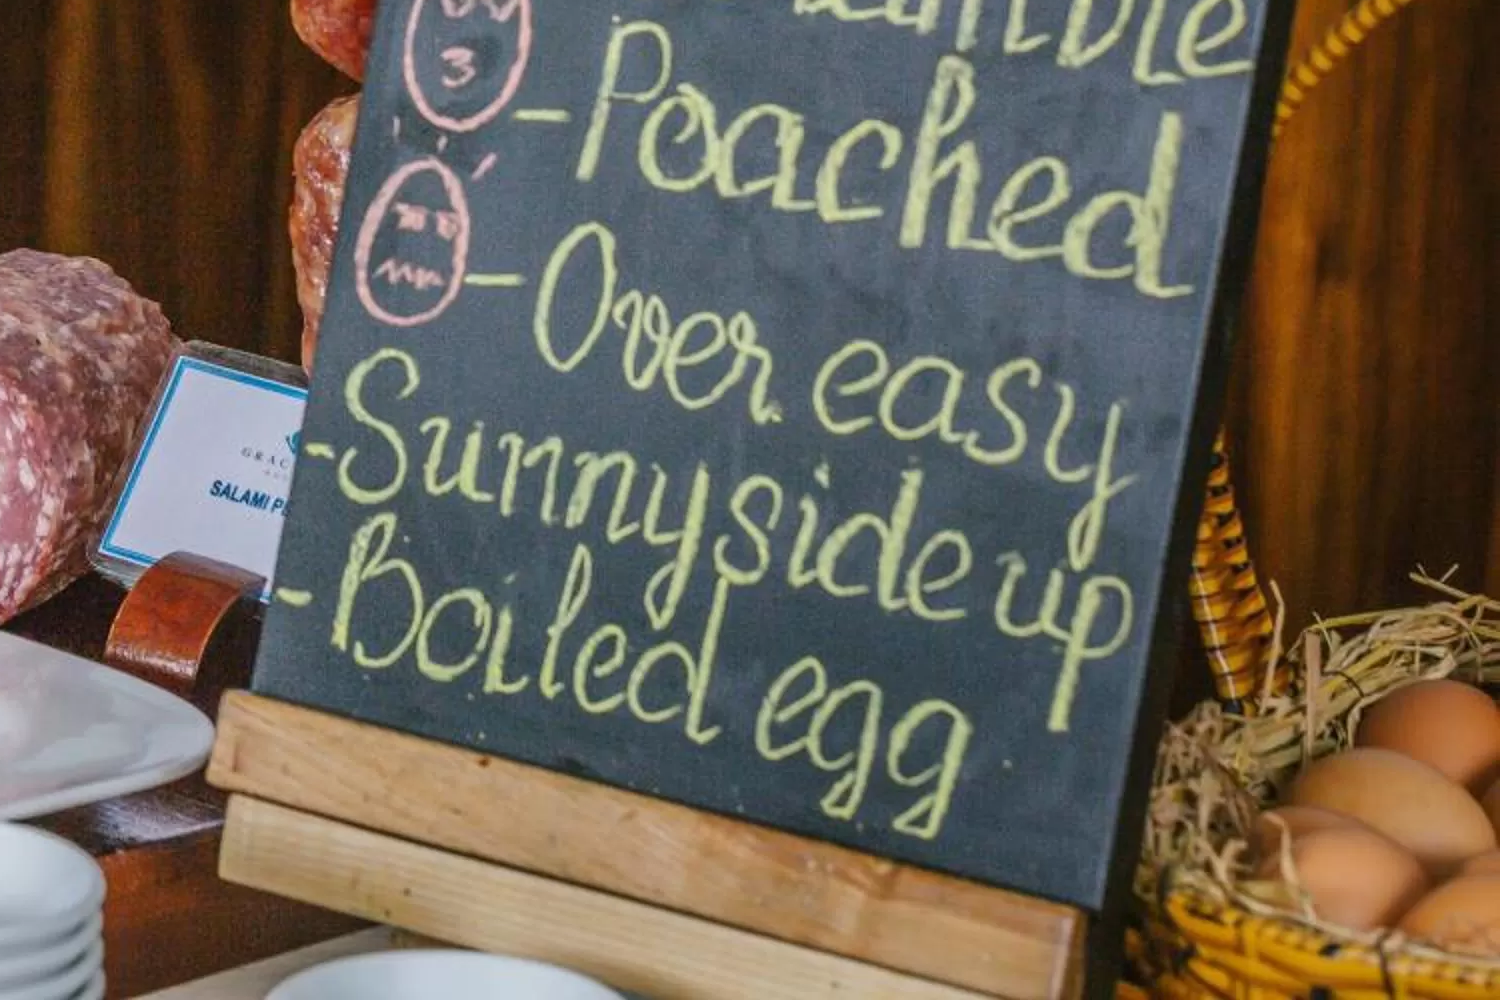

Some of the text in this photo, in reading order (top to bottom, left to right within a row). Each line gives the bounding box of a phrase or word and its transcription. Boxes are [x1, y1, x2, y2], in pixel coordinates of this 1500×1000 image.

[578, 16, 1197, 299] Poached
[209, 479, 270, 510] SALAMI
[534, 222, 783, 425] Over
[813, 340, 1139, 572] easy
[330, 512, 729, 744] Boiled
[755, 656, 973, 839] egg
[995, 549, 1134, 732] up
